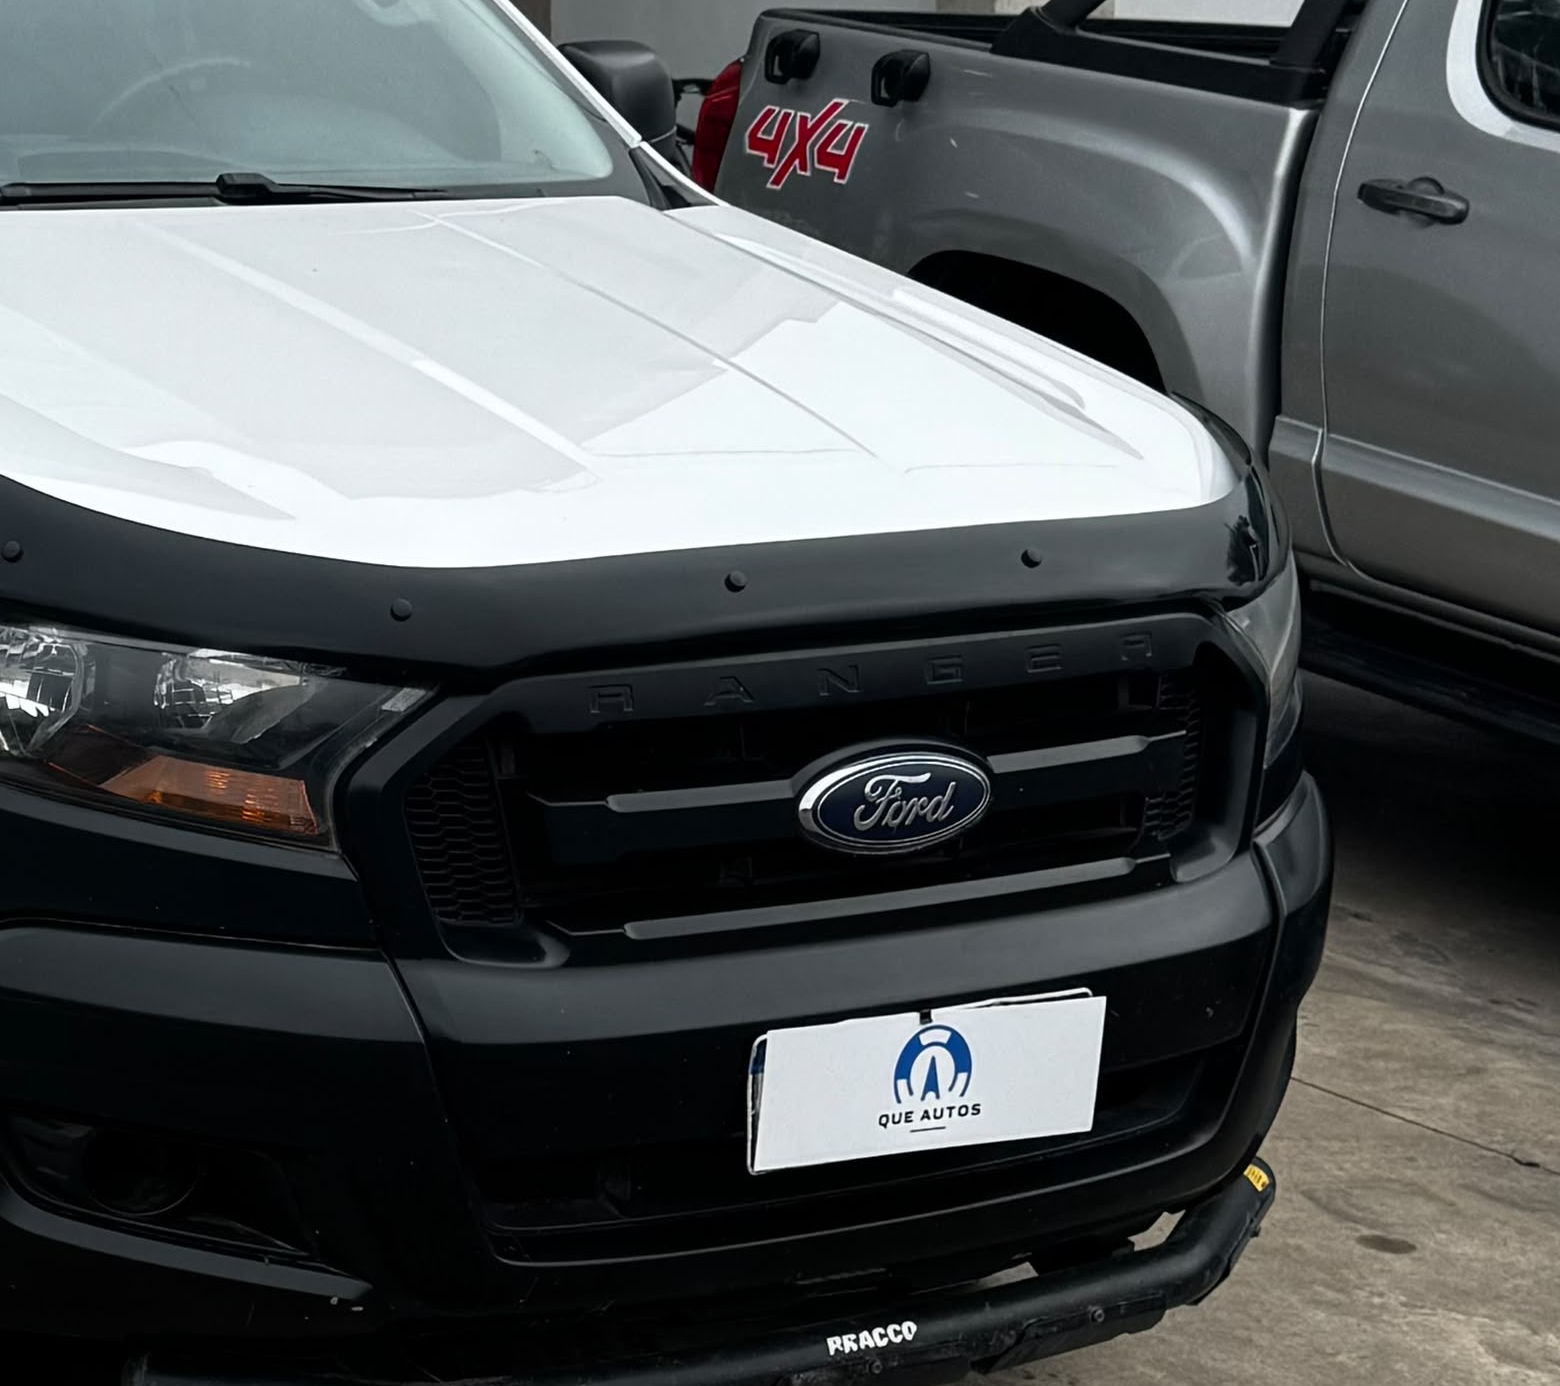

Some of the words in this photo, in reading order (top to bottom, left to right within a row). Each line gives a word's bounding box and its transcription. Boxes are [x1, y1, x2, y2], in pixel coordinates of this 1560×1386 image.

[588, 631, 1153, 714] RANGER
[853, 771, 956, 832] Ford
[878, 1110, 915, 1128] QUE
[920, 1103, 983, 1121] AUTOS
